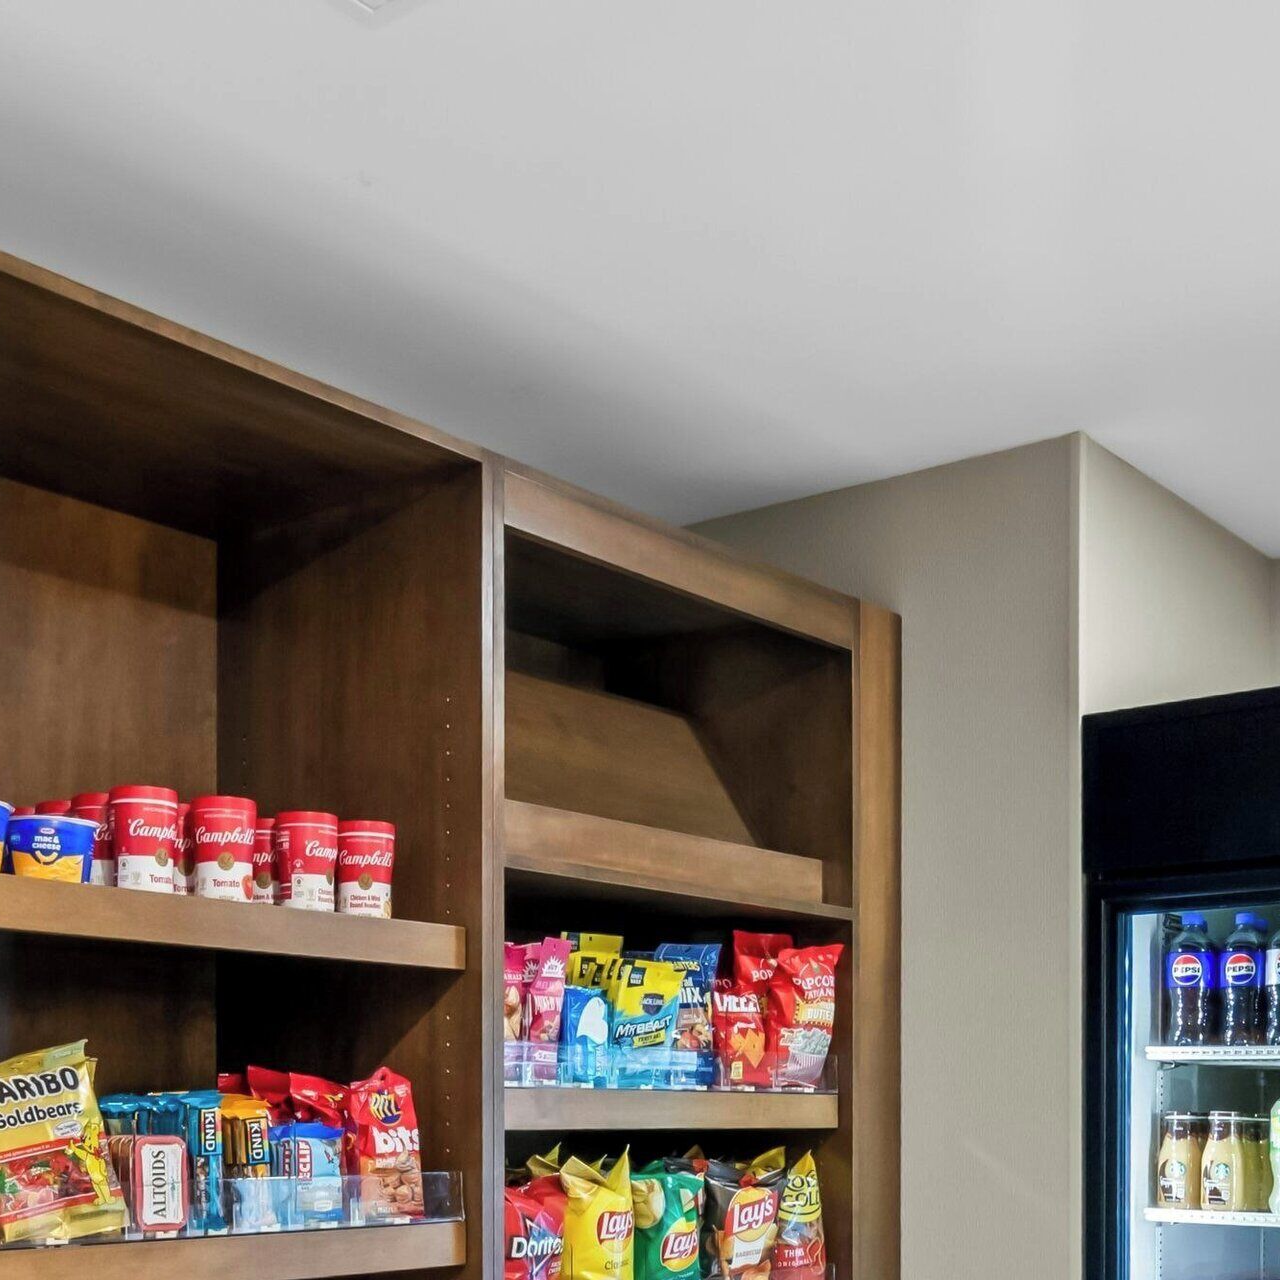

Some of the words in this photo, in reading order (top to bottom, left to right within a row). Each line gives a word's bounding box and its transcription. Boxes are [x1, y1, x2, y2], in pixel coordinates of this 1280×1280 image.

[31, 842, 62, 851] cheese
[34, 835, 52, 844] mac
[52, 836, 60, 844] &
[212, 878, 240, 889] Tomato
[1226, 964, 1254, 975] PEPSI
[205, 1111, 216, 1152] KIND
[251, 1121, 263, 1161] KIND
[372, 1126, 420, 1154] bits
[152, 1148, 167, 1218] ALTOIDS
[599, 1213, 634, 1241] Lay's
[732, 1195, 773, 1232] Lay's
[663, 1232, 699, 1260] Lay's
